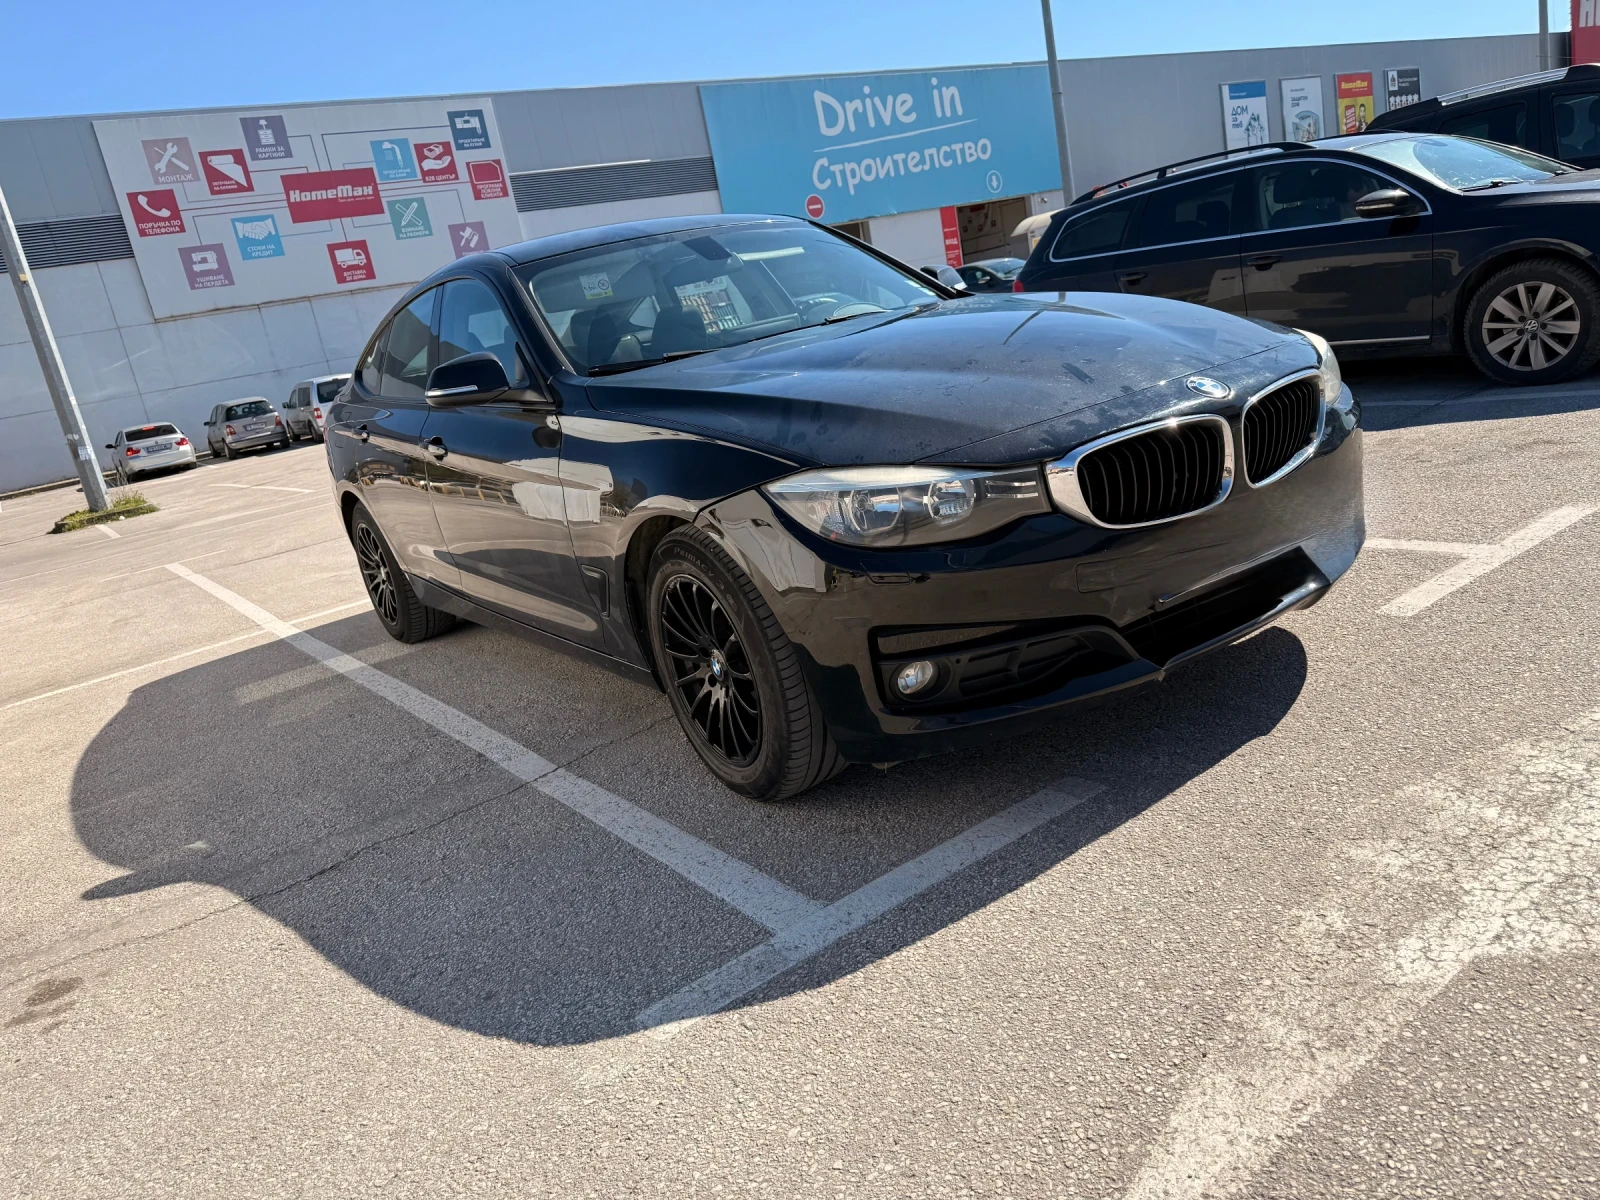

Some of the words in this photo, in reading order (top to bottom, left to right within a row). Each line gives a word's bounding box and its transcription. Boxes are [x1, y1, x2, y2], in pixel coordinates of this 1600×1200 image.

[813, 85, 917, 137] Drive
[931, 77, 963, 118] in
[812, 138, 992, 196] Строителство
[158, 174, 194, 183] МОНТАЖ
[289, 185, 373, 202] HomeMax
[138, 221, 171, 230] ПОРЪЧКА
[145, 226, 181, 235] ТЕЛЕФОНА
[251, 249, 273, 257] КРЕДИТ
[203, 279, 229, 287] ПЕРДЕТА
